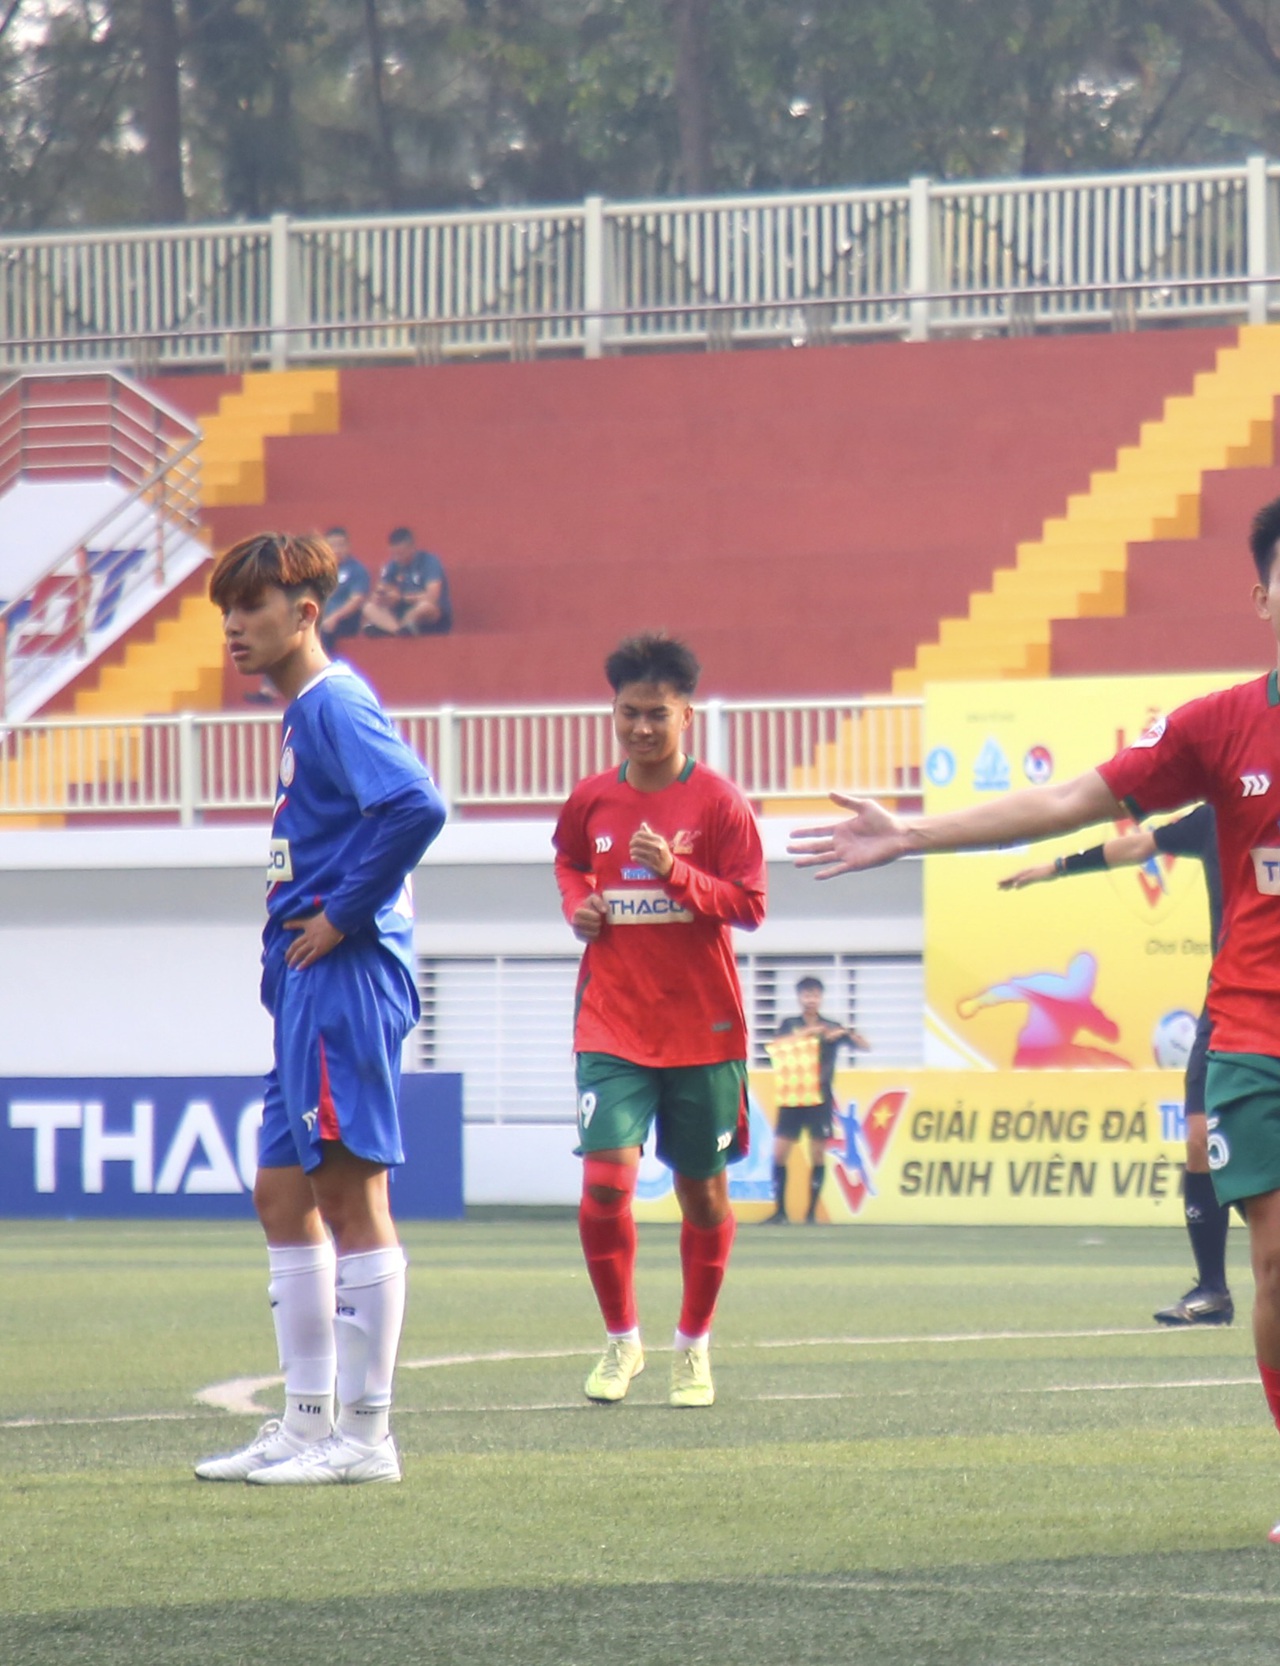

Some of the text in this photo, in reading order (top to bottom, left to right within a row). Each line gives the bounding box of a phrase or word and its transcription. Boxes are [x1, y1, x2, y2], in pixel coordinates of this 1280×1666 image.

[910, 1101, 979, 1142] GIẢI
[1100, 1101, 1149, 1142] ĐÁ
[900, 1161, 992, 1197] SINH
[1009, 1153, 1097, 1197] VIÊN
